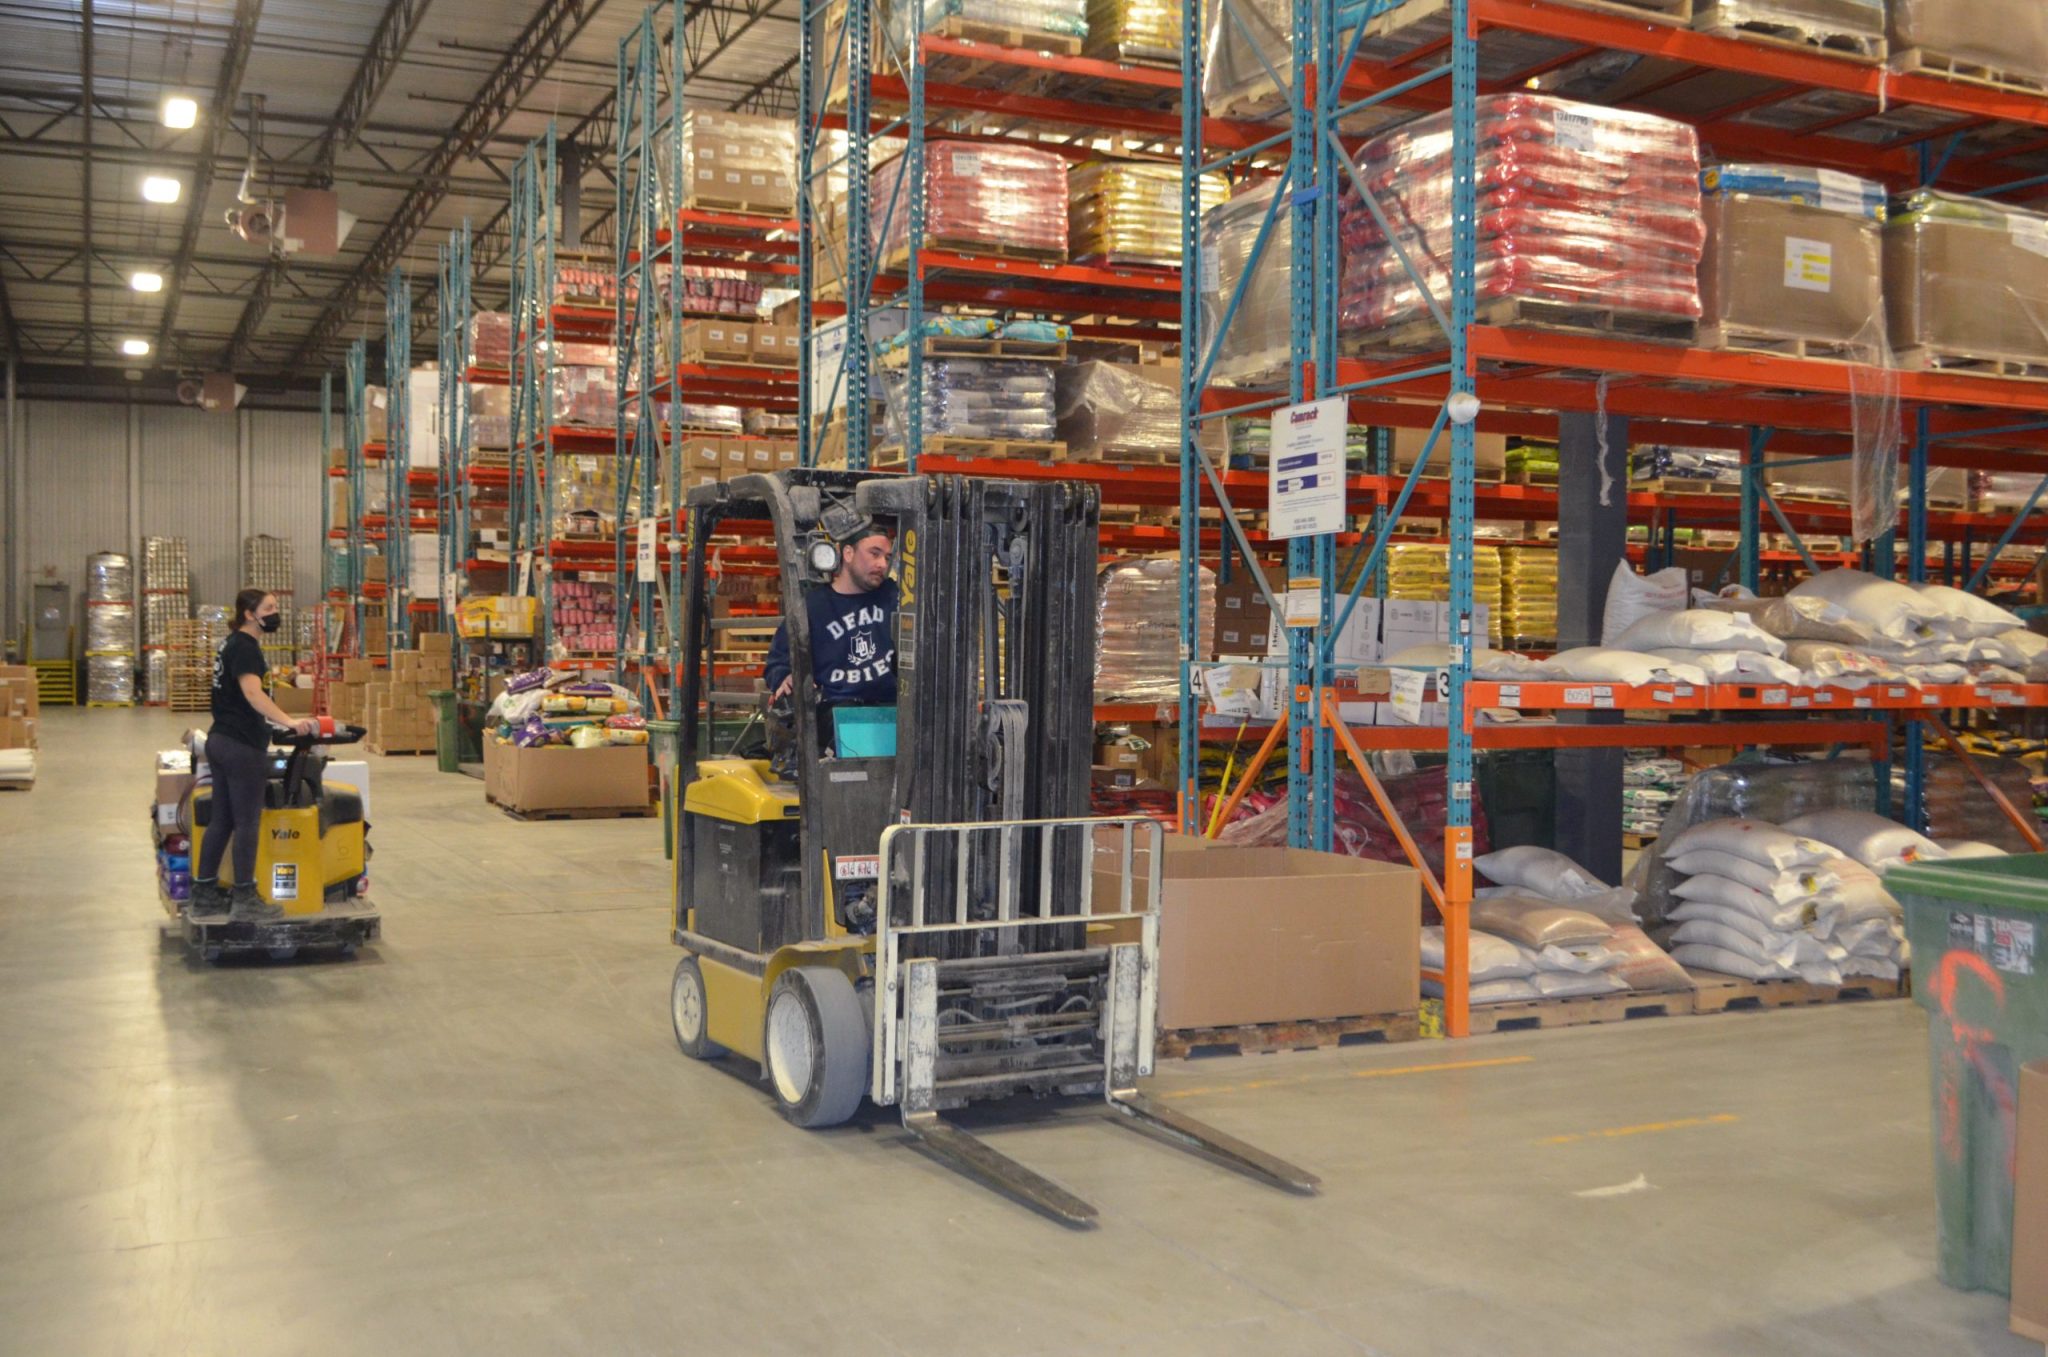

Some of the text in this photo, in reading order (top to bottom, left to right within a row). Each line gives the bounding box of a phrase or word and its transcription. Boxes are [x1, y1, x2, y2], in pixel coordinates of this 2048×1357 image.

[901, 529, 917, 607] Yale
[826, 604, 884, 641] DEAD
[1192, 670, 1202, 691] 4
[1439, 672, 1450, 698] 3
[271, 828, 301, 840] Yale
